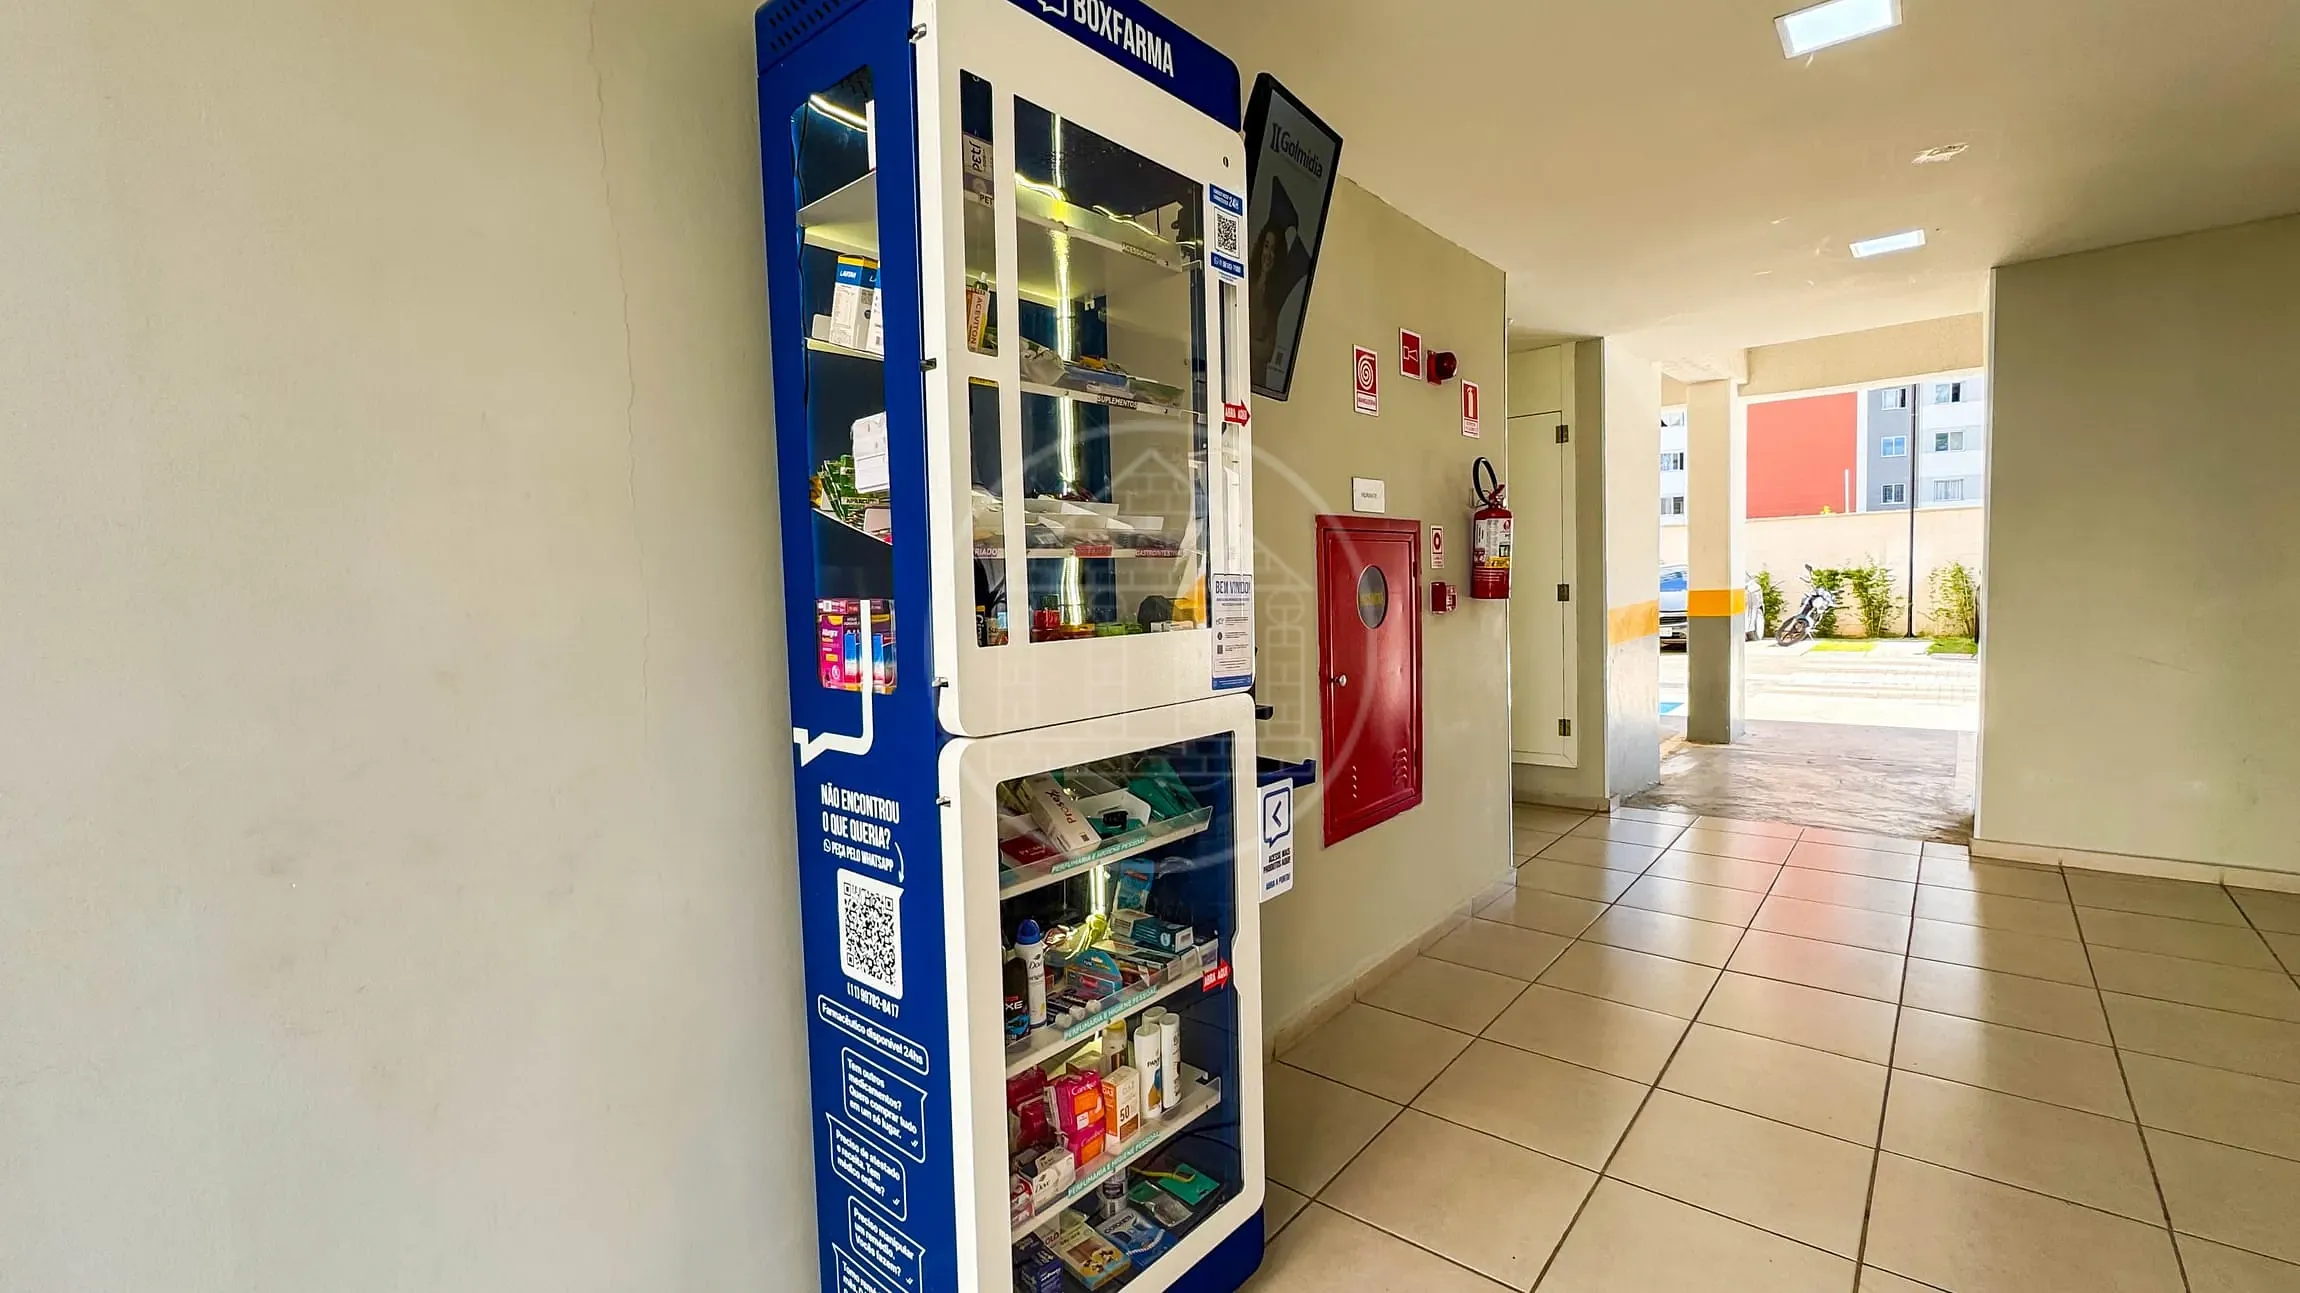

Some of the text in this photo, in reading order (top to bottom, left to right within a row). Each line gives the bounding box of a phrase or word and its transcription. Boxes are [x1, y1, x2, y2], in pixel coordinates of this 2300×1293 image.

[1073, 0, 1174, 78] BOXFARMA
[821, 782, 900, 824] NÃO ENCONTROU
[822, 811, 891, 850] O QUE QUERIA?
[832, 841, 894, 872] PEÇA PELO WHATSAPP
[1005, 1000, 1023, 1010] XE
[822, 1002, 924, 1065] Farmacêutico disponível 24hs
[847, 1057, 885, 1088] Tem outros
[848, 1073, 902, 1111] medicamentos?
[849, 1099, 861, 1112] em
[861, 1106, 872, 1120] um
[881, 1117, 902, 1139] lugar.
[870, 1099, 899, 1123] comprar
[900, 1115, 917, 1134] tudo
[1120, 1104, 1130, 1122] 50
[836, 1129, 860, 1153] Preciso
[860, 1147, 869, 1160] de
[837, 1156, 885, 1197] médico online?
[865, 1162, 881, 1181] Tem
[1068, 1167, 1107, 1198] PERFUMARIA
[853, 1206, 914, 1260] Preciso manipular
[854, 1221, 896, 1260] um remédio.
[854, 1231, 902, 1277] Vocês fazem?
